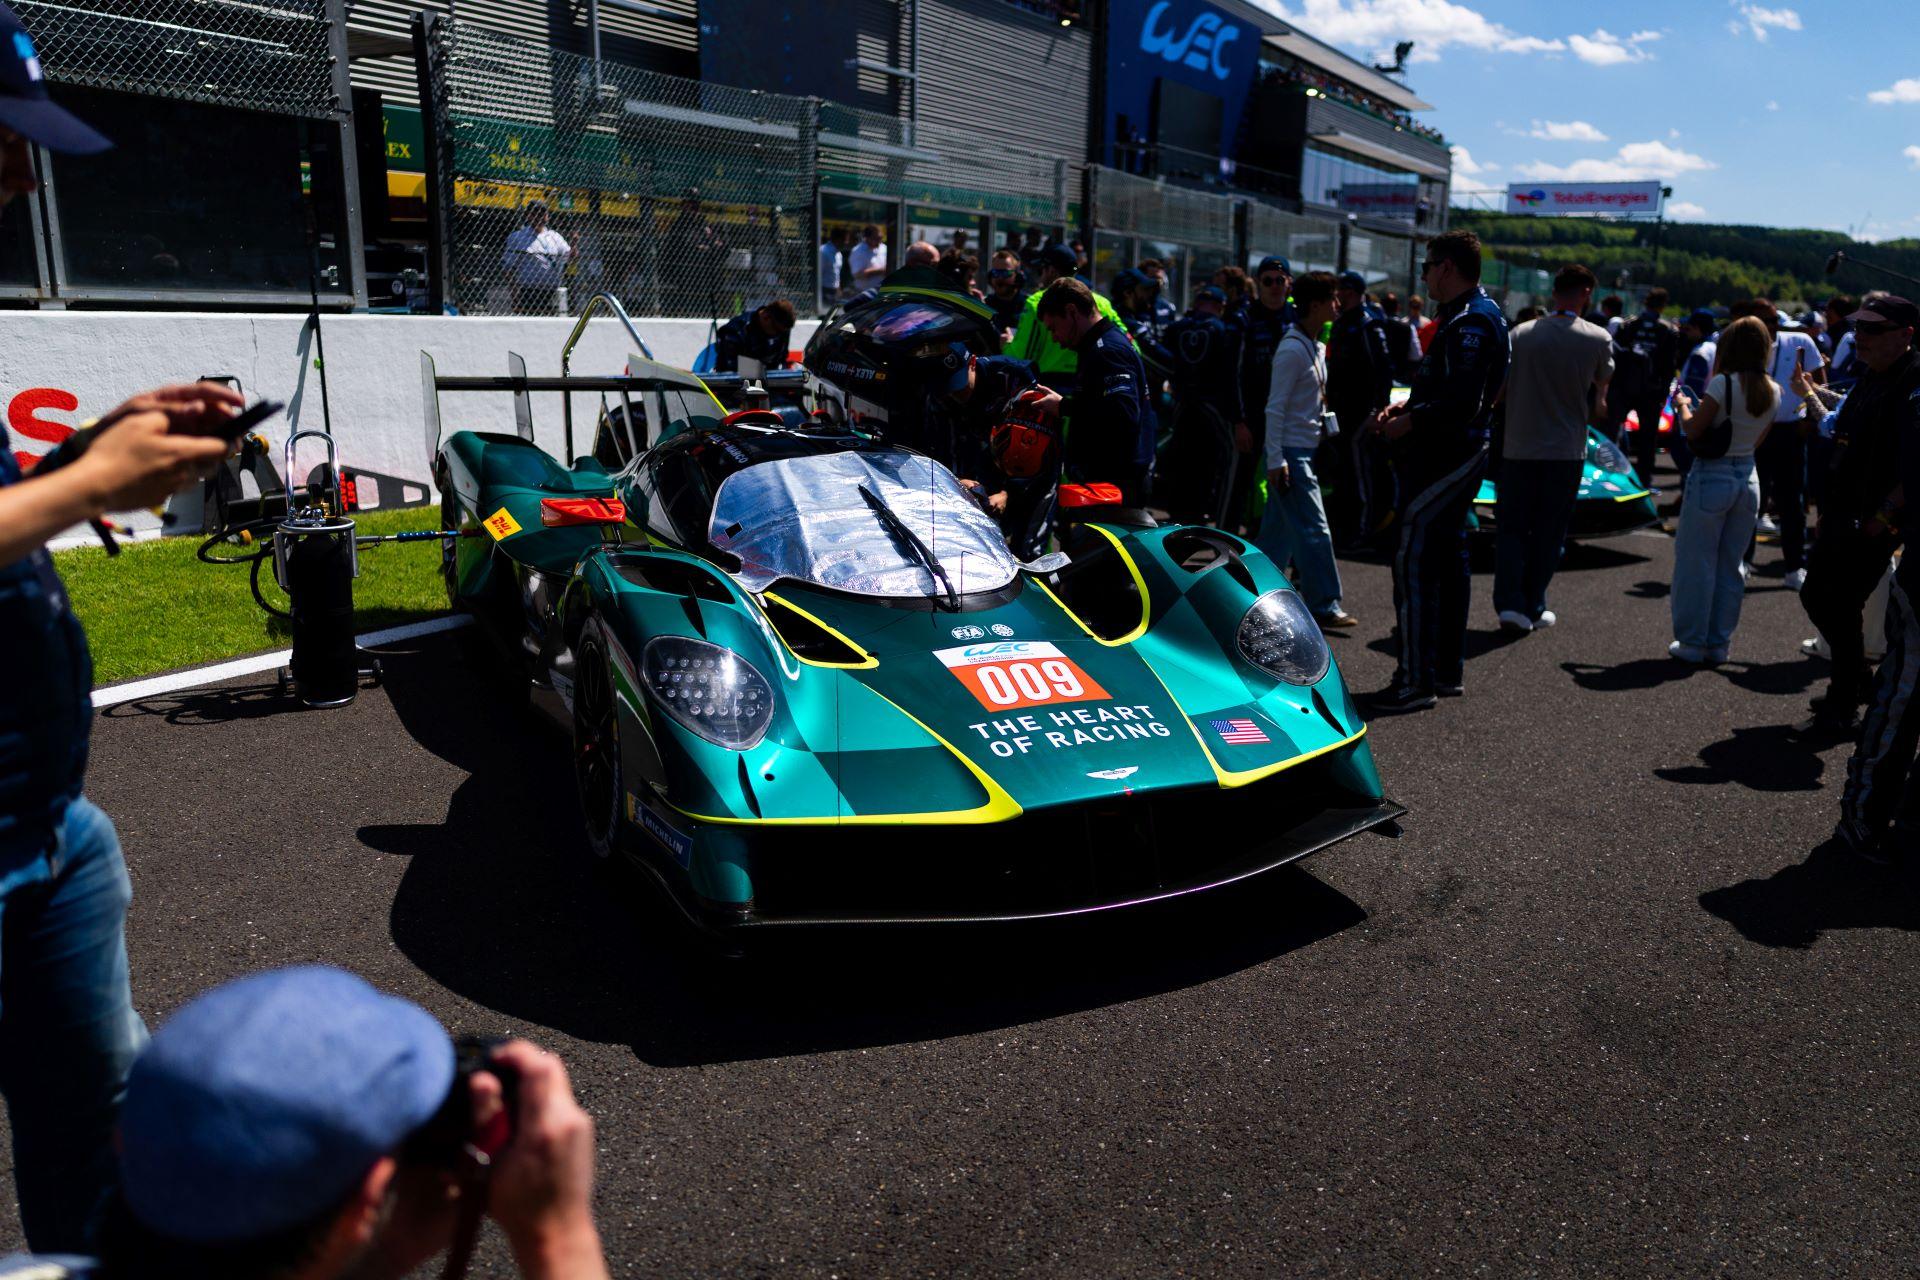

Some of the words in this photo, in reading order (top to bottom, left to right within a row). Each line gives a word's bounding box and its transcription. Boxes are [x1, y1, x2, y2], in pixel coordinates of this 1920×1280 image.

[1140, 0, 1240, 80] WEC
[1552, 190, 1650, 207] TotalEnergies
[347, 481, 357, 504] GET
[953, 626, 983, 639] FIA
[964, 643, 1030, 657] WEC
[976, 660, 1084, 705] 009
[969, 715, 1042, 739] THE
[1048, 705, 1155, 727] HEART
[989, 735, 1033, 757] OF
[1044, 722, 1171, 748] RACING
[645, 814, 685, 855] MICHELIN
